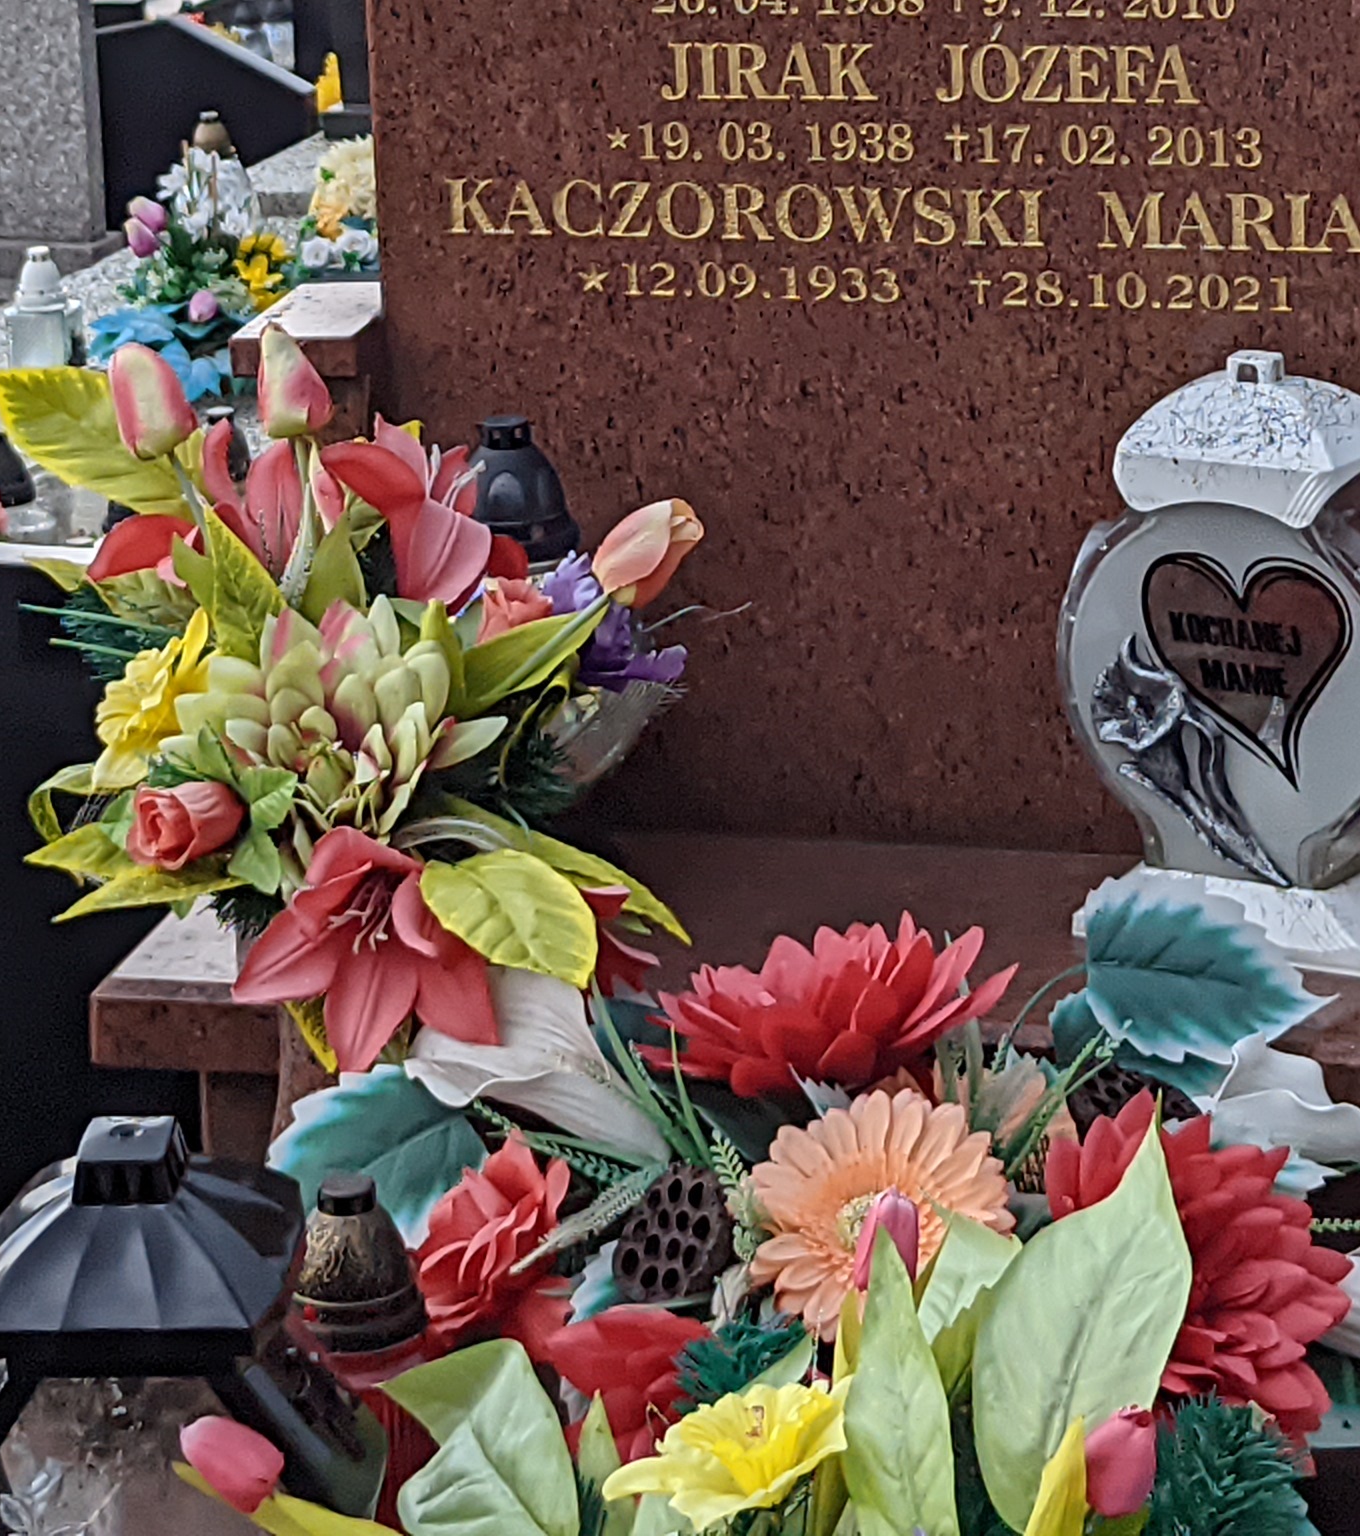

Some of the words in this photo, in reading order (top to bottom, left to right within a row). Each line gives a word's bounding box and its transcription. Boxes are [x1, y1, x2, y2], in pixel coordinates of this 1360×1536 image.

[660, 42, 879, 102] JIRAK
[935, 30, 1200, 106] JÓZEFA
[641, 121, 704, 162] 19.
[718, 121, 787, 163] 03.
[807, 122, 915, 164] 1938
[977, 124, 1044, 165] 17.
[1060, 124, 1131, 167] 02.
[1147, 125, 1264, 169] 2013
[445, 177, 1046, 247] KACZOROWSKI
[623, 262, 901, 305] 12.09.1933
[1001, 270, 1294, 313] 28.10.2021
[1168, 610, 1302, 657] KOCHANEJ
[1199, 658, 1290, 698] MAMIE
